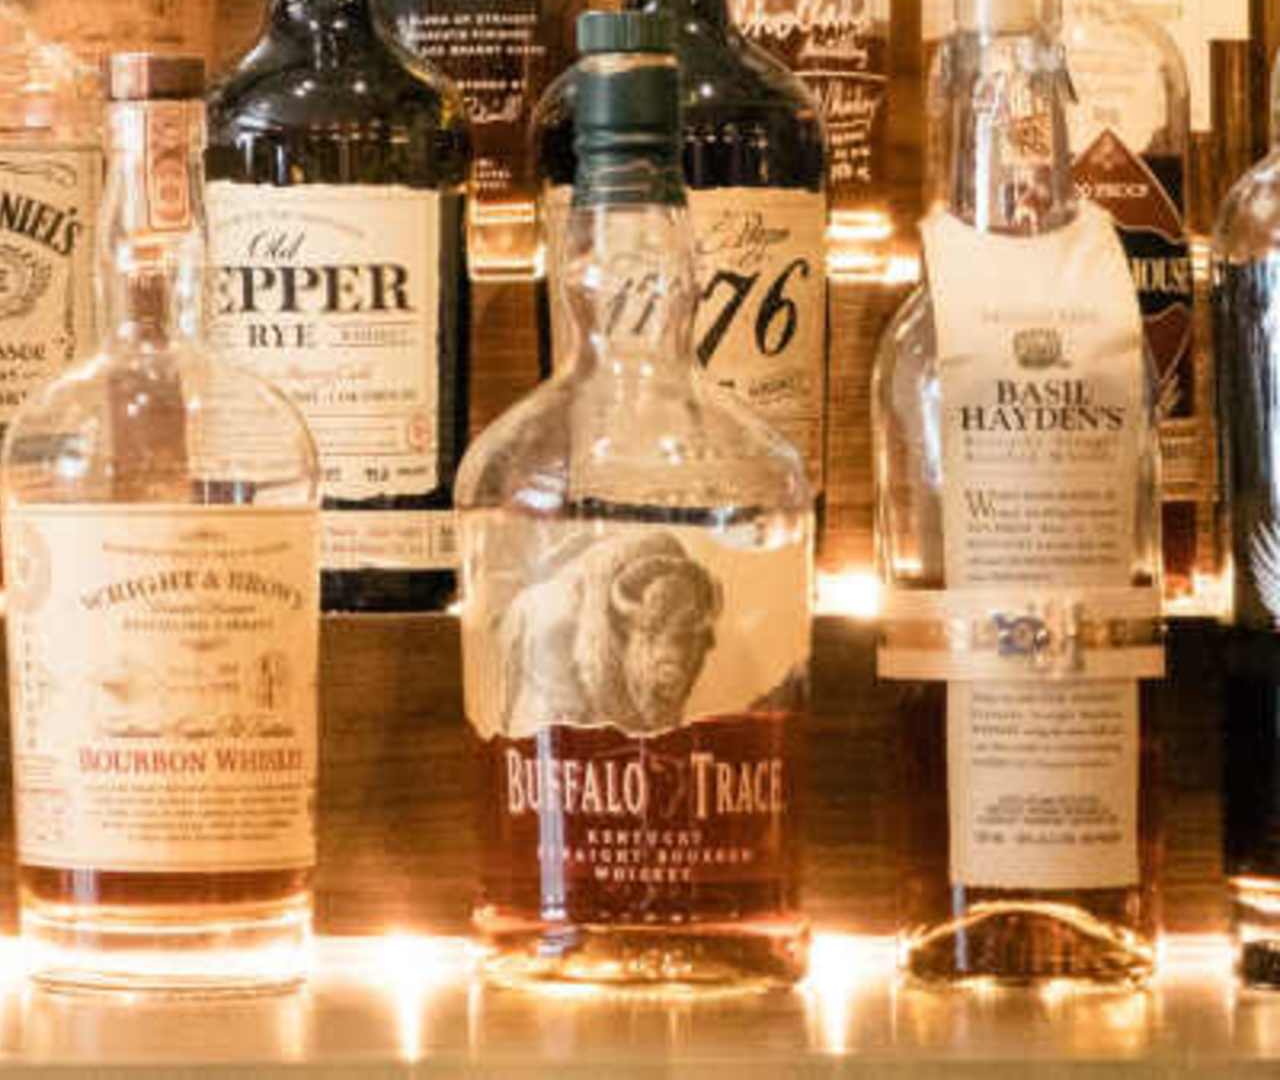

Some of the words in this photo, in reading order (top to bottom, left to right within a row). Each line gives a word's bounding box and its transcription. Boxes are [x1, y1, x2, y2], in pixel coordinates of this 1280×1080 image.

[248, 230, 307, 261] Old
[248, 323, 314, 349] RYE
[996, 379, 1091, 406] BASIL
[959, 406, 1128, 432] HAYDEN'S
[78, 747, 208, 772] BOURBON
[505, 748, 647, 815] BUFFALO
[690, 751, 784, 819] TRACE
[587, 828, 703, 846] KENTUCKY
